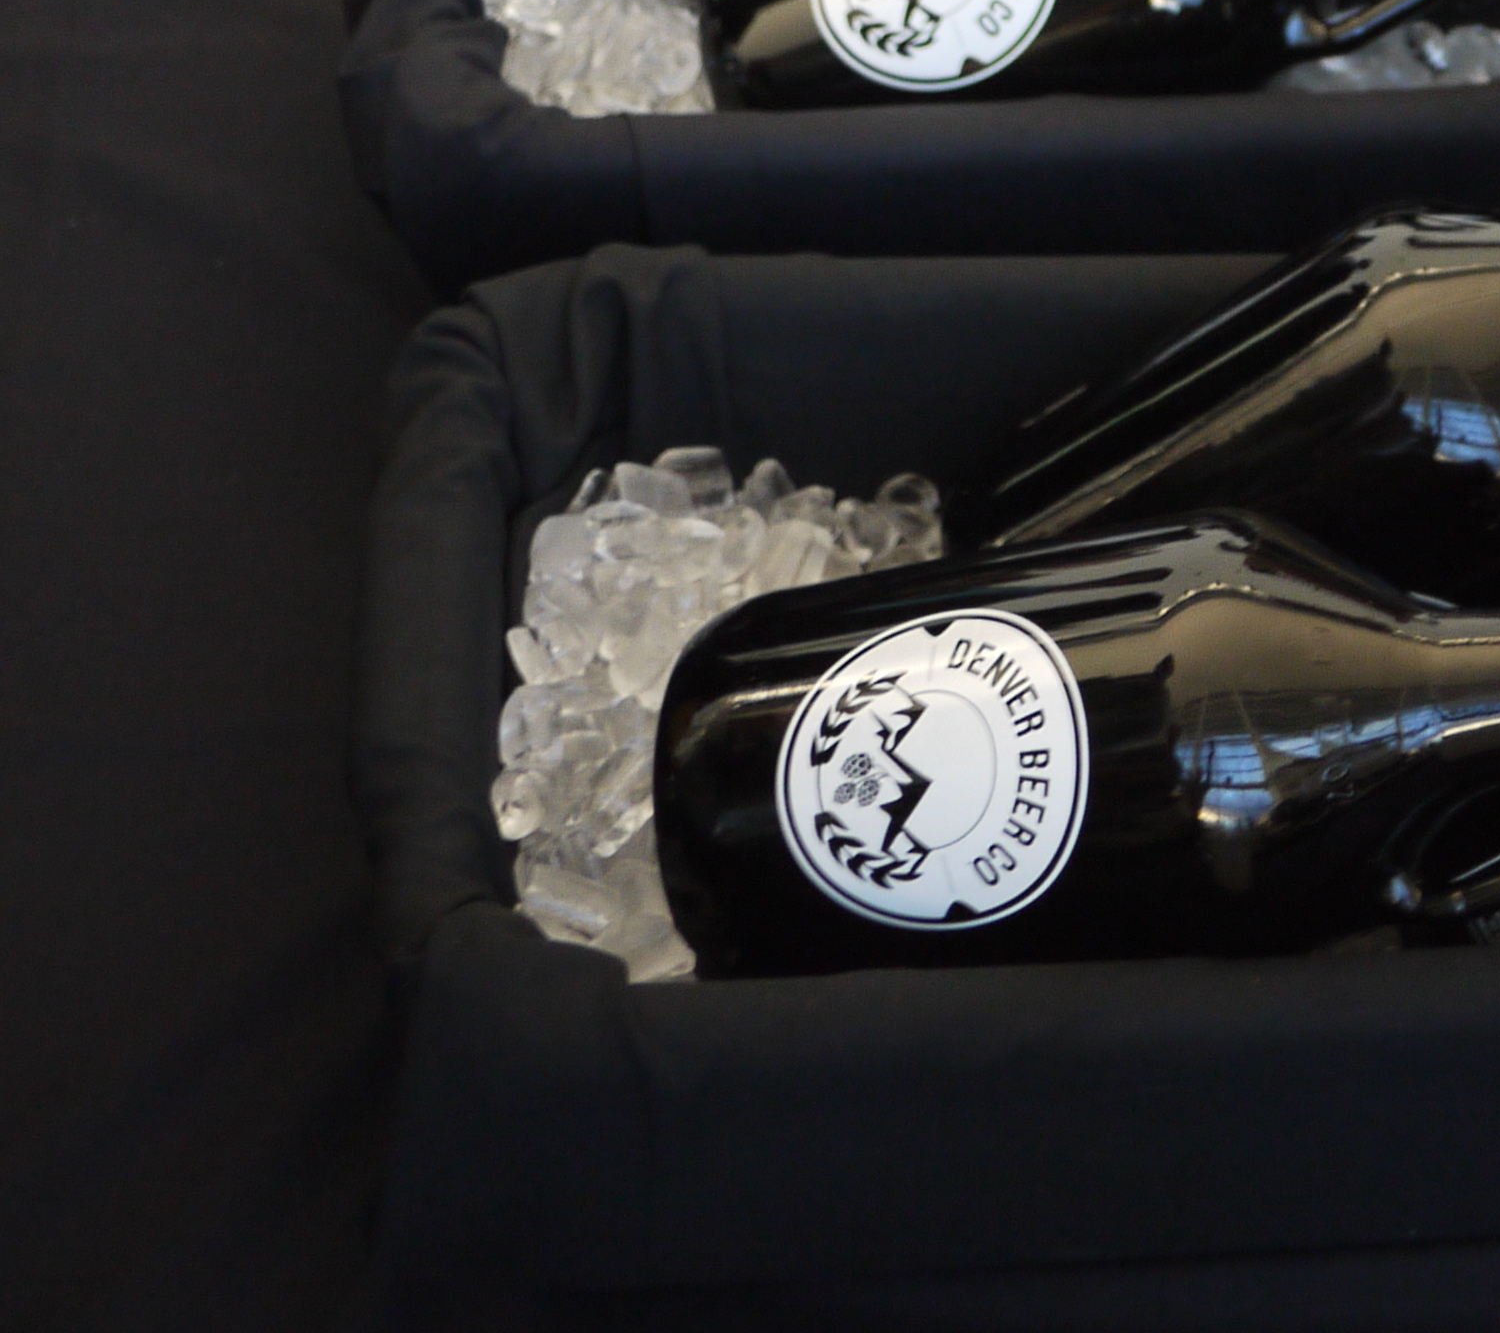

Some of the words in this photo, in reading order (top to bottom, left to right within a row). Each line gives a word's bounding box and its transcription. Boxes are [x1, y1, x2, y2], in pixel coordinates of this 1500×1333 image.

[975, 1, 1015, 38] CO
[947, 638, 1046, 738] DENVER
[1002, 748, 1051, 848] BEER
[972, 842, 1017, 887] CO
